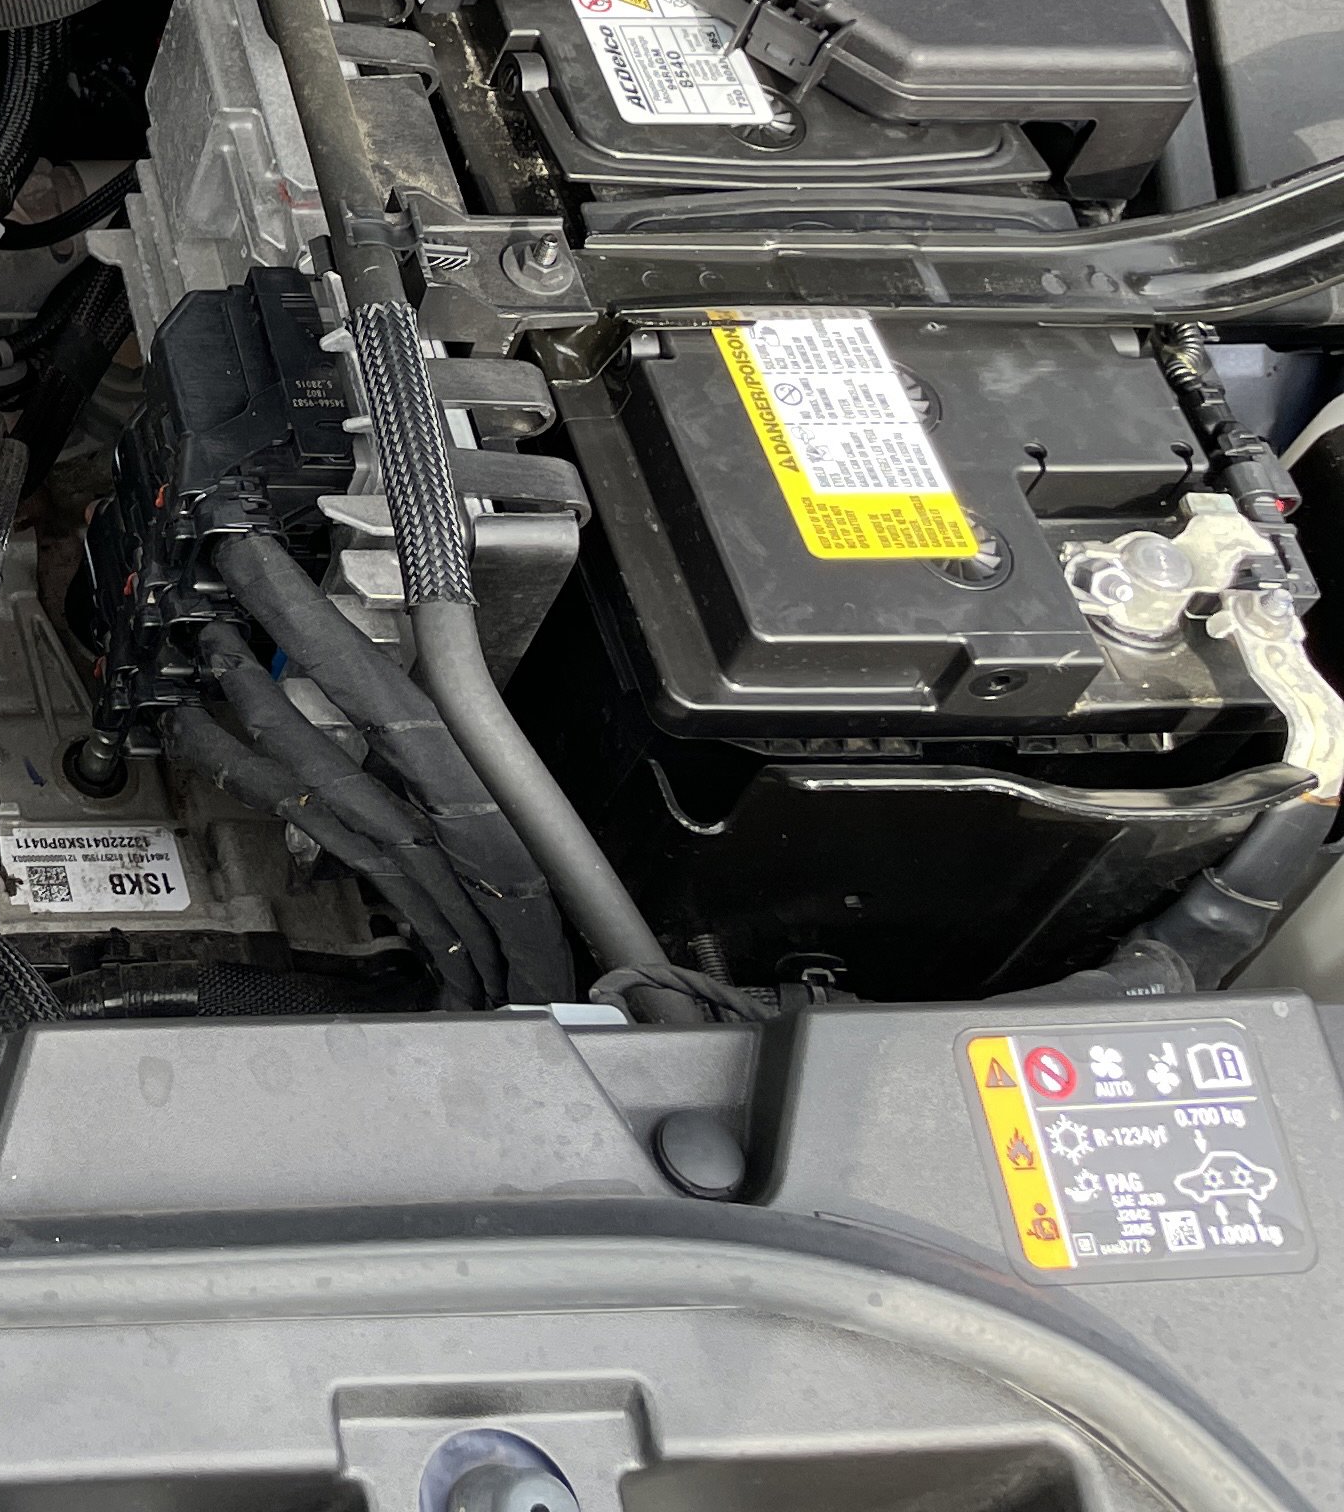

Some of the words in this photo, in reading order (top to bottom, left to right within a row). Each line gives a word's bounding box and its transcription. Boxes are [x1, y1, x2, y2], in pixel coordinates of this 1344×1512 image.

[600, 26, 645, 109] ACDelco
[723, 327, 790, 454] DANGER/POISON
[108, 872, 176, 895] 1SKB
[1095, 1080, 1134, 1097] AUTO
[1174, 1107, 1220, 1128] 0.700
[1220, 1106, 1246, 1128] kg
[1093, 1125, 1169, 1148] R-1234yf
[1105, 1172, 1144, 1193] PAG
[1208, 1224, 1258, 1246] 1.000
[1258, 1223, 1284, 1247] kg
